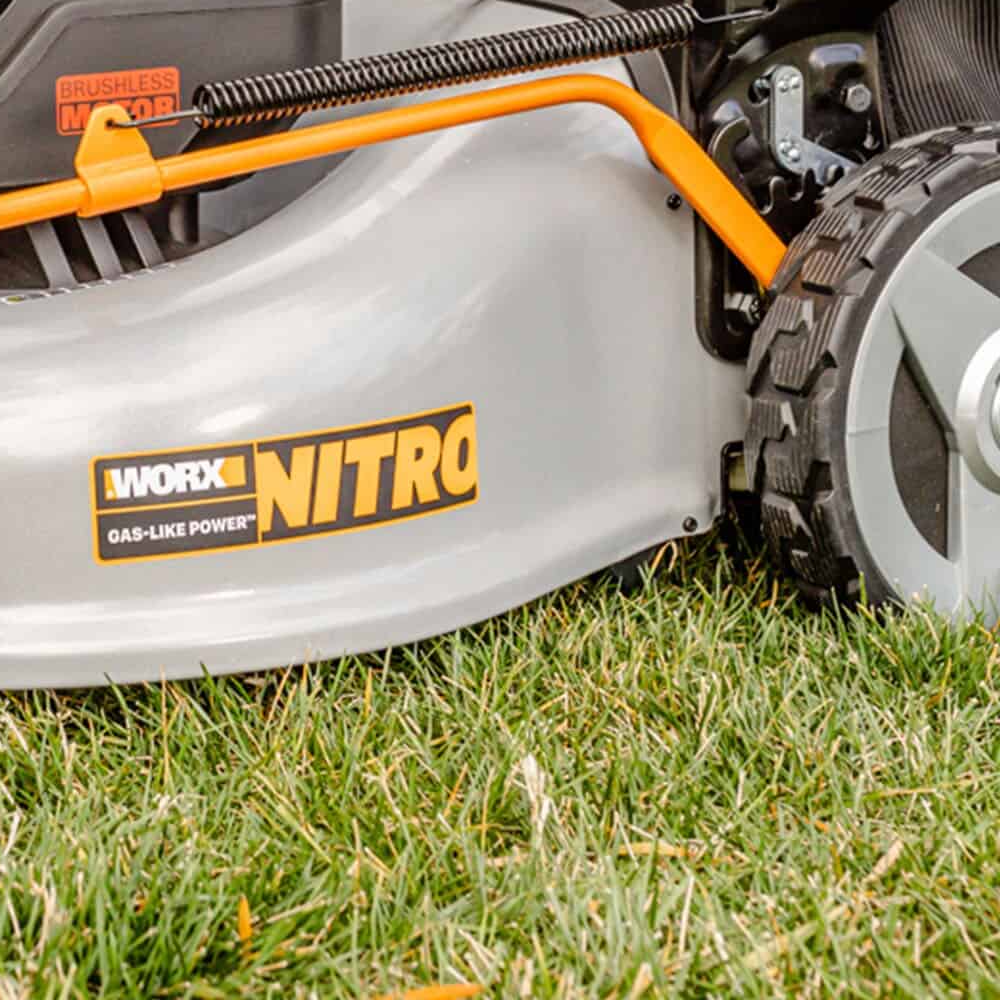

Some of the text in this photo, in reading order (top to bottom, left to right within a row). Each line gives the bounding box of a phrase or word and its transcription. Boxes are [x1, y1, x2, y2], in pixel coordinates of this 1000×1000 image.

[60, 72, 175, 99] BRUSHLESS
[61, 96, 176, 130] MOR
[108, 457, 228, 499] WORX
[256, 413, 477, 533] NITRO
[107, 521, 186, 544] GAS-LIKE
